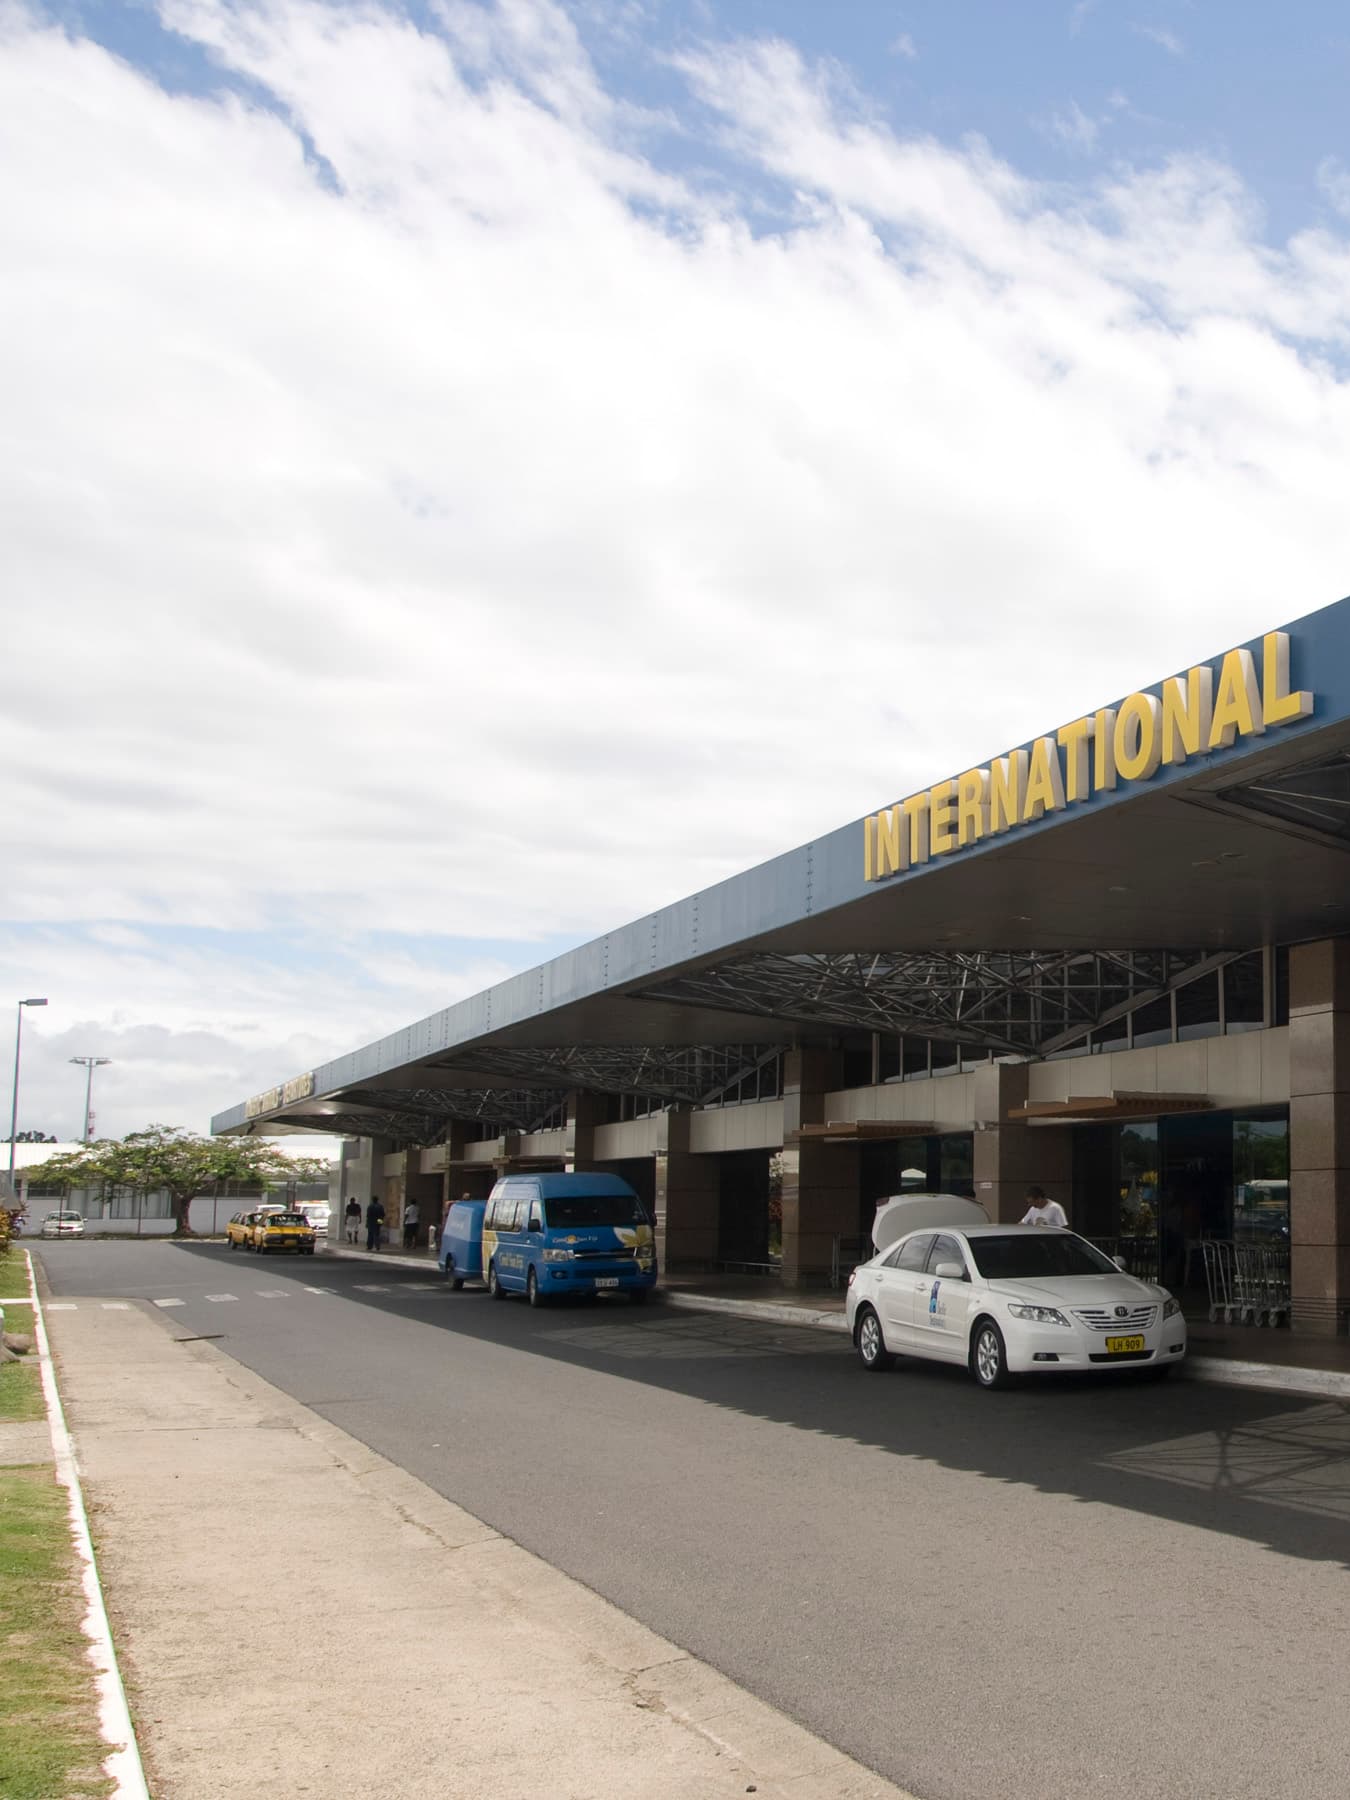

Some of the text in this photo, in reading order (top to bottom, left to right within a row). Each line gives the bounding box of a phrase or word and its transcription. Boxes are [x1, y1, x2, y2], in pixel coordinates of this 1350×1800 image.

[864, 631, 1314, 882] INTERNATIONAL
[1113, 1339, 1140, 1351] LH 909
